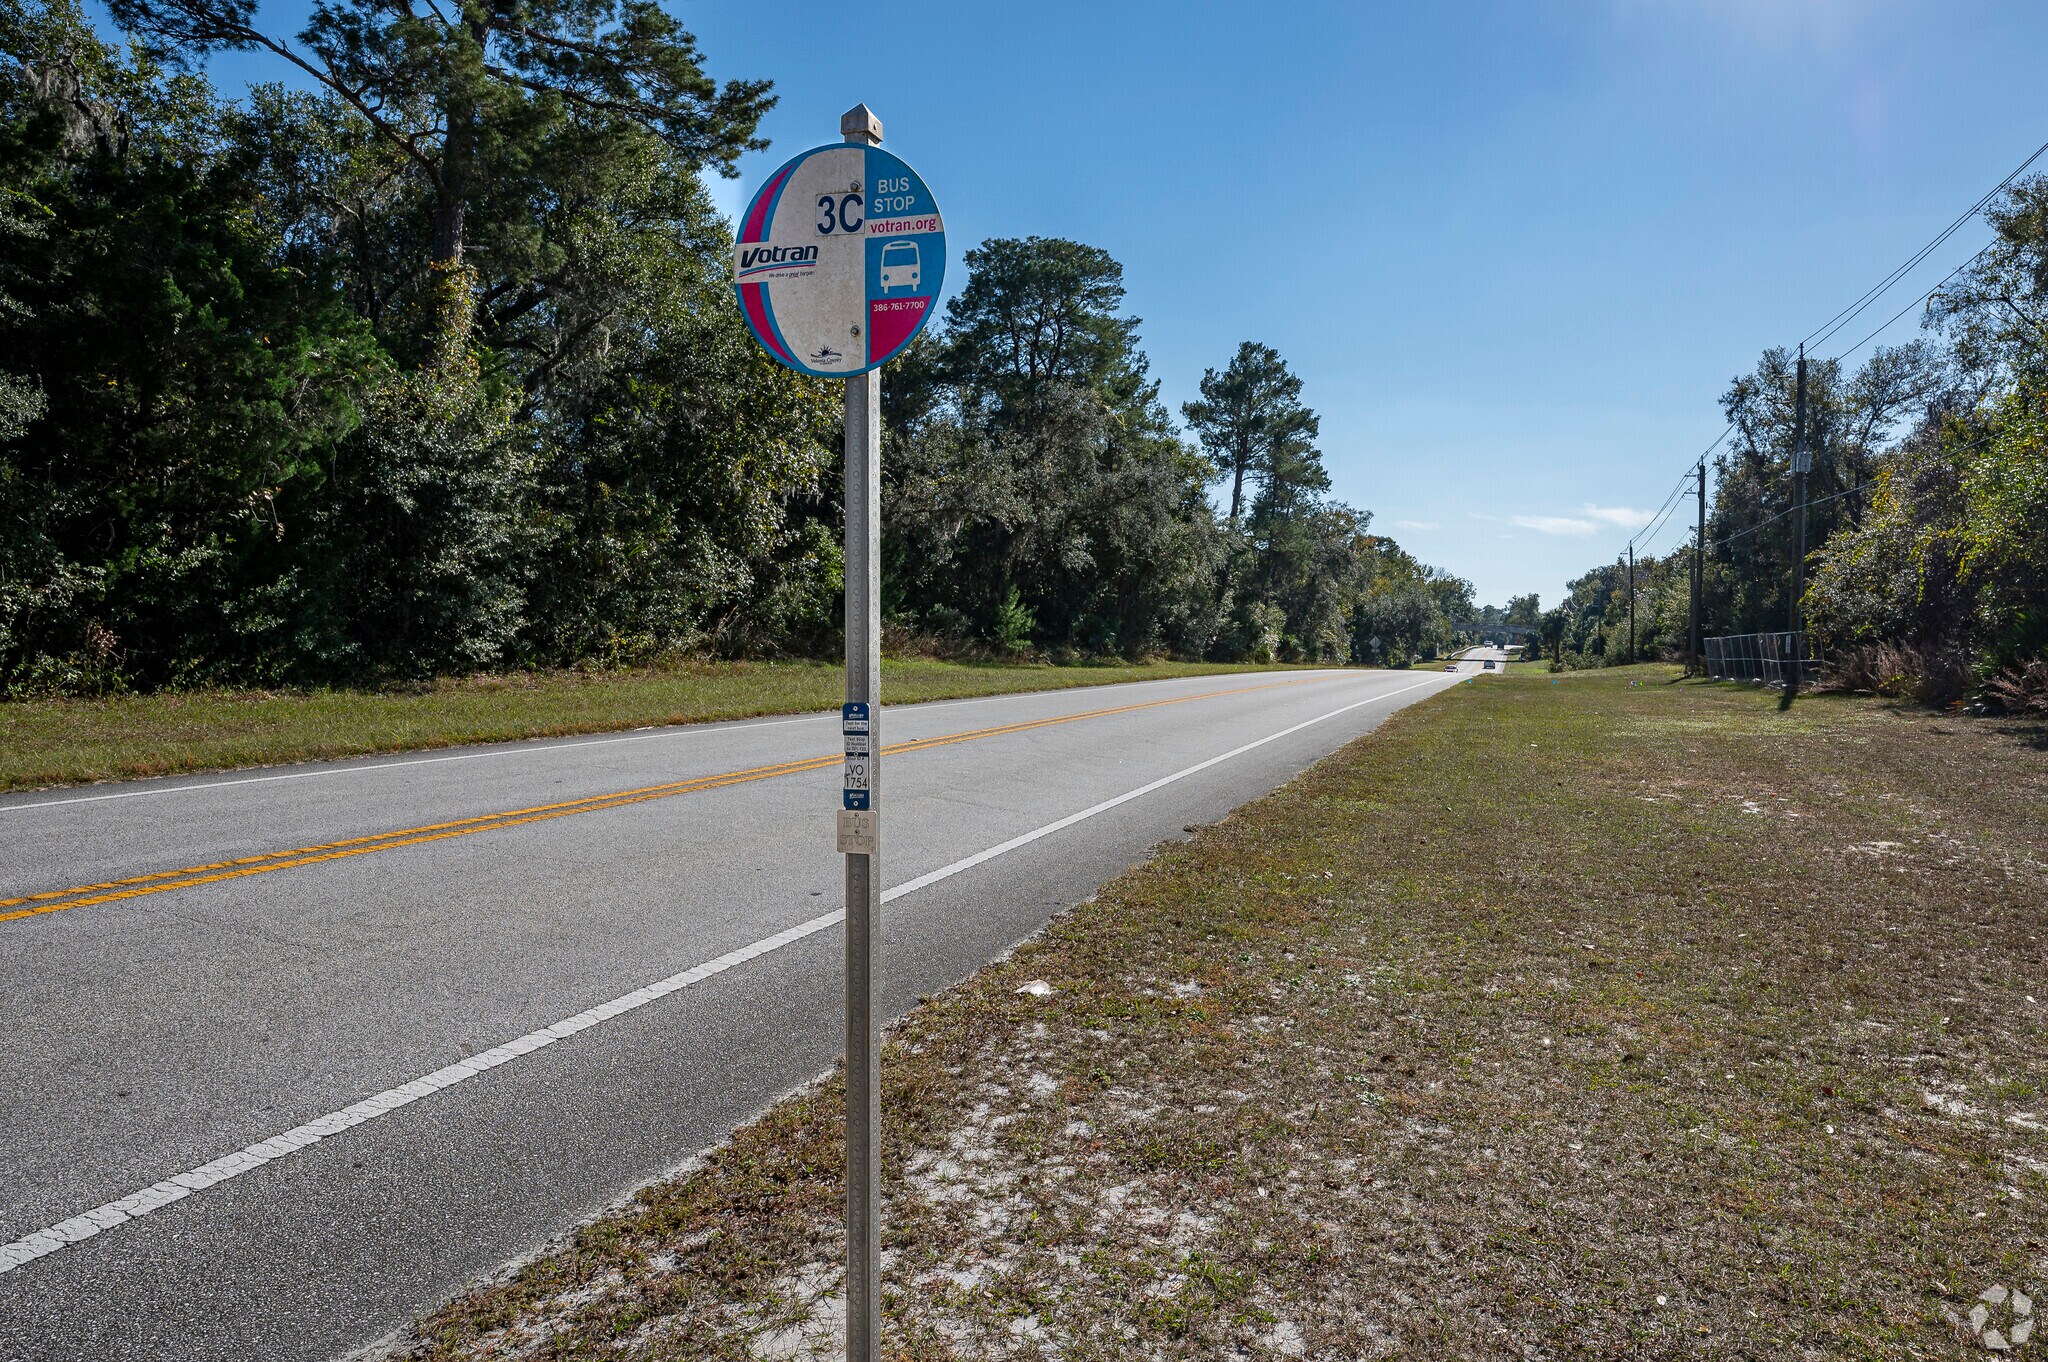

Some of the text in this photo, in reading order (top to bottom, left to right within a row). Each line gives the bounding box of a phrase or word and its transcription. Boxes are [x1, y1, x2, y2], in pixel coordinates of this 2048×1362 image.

[878, 177, 909, 193] BUS
[874, 196, 915, 212] STOP
[817, 194, 863, 234] 3C
[870, 218, 936, 233] votran.org
[741, 246, 818, 268] Votran
[849, 765, 864, 776] VO
[846, 777, 867, 788] 1754
[843, 817, 869, 828] BUS
[840, 835, 874, 846] STOP
